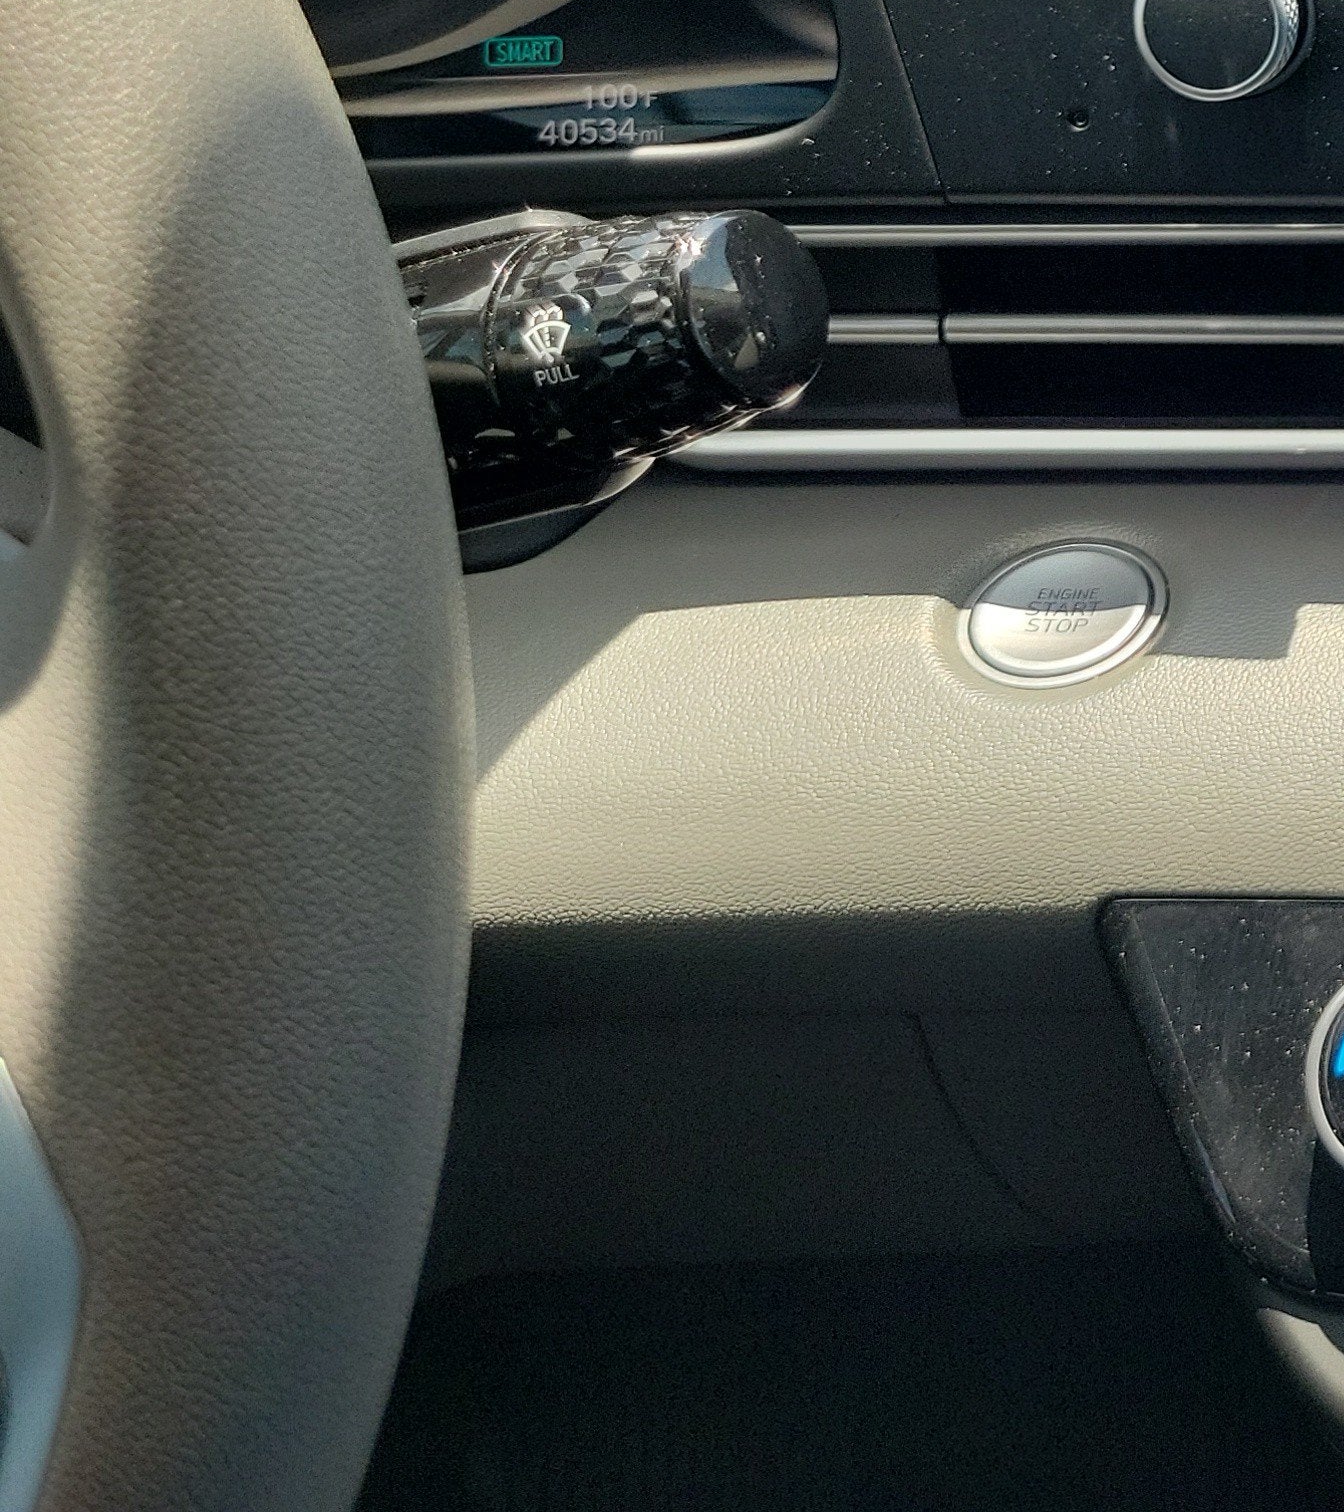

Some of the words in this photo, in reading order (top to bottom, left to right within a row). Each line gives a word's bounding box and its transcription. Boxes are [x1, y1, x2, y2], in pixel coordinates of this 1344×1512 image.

[497, 41, 554, 62] SMART
[538, 117, 638, 146] 40534
[534, 363, 580, 387] PULL
[1037, 587, 1100, 600] ENGINE
[1025, 600, 1103, 617] START
[1024, 617, 1089, 633] STOP
